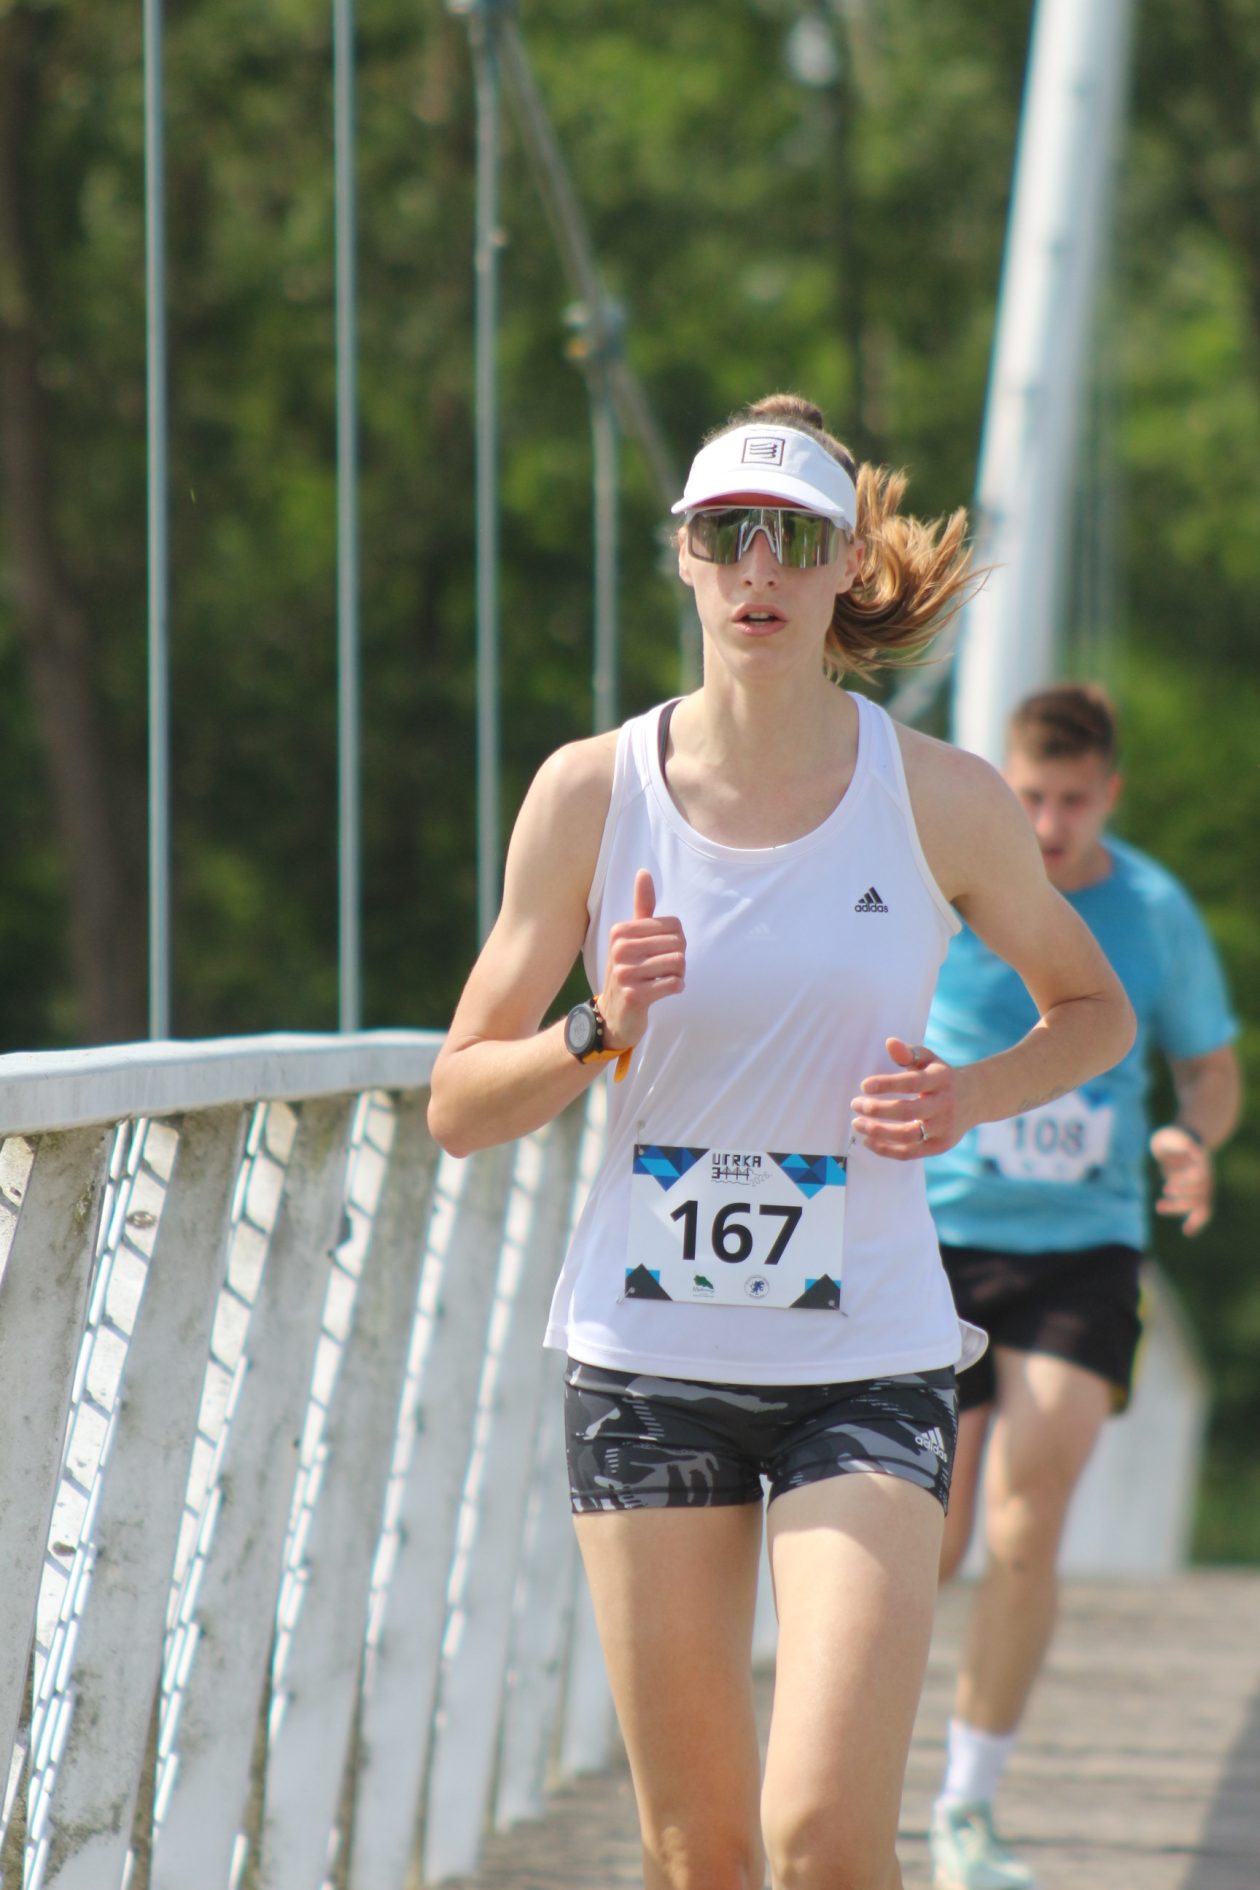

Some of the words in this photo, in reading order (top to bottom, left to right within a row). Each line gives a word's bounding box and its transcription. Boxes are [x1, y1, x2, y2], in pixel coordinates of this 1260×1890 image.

[854, 903, 889, 913] adidas
[1010, 1115, 1086, 1157] 108
[670, 1199, 803, 1266] 167
[914, 1436, 948, 1463] adidas
